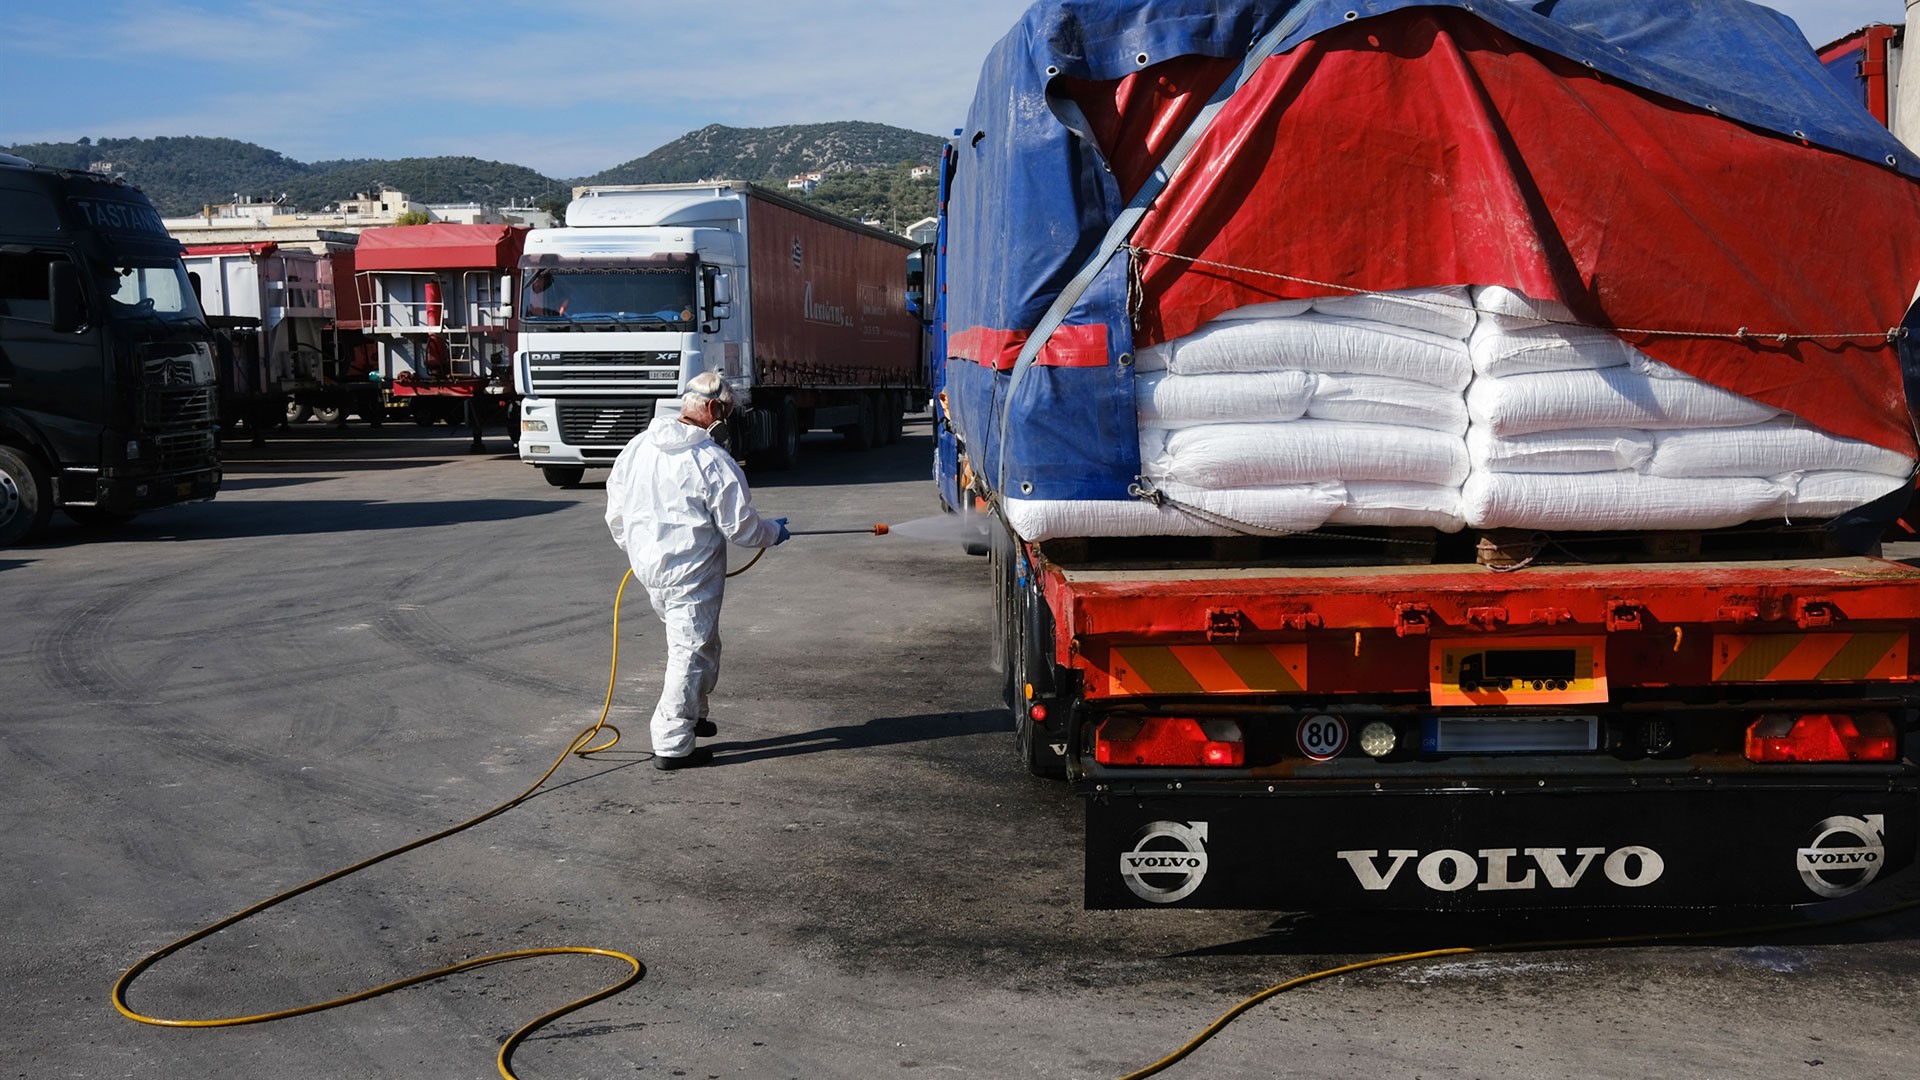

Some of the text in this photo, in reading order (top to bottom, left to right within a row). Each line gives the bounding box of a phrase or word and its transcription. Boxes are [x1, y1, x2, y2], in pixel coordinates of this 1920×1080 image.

[531, 353, 561, 361] DAF
[1308, 722, 1338, 747] 80
[1422, 737, 1437, 747] GR
[1127, 857, 1201, 868] VOLVO
[1804, 852, 1878, 864] VOLVO
[1337, 846, 1665, 892] VOLVO
